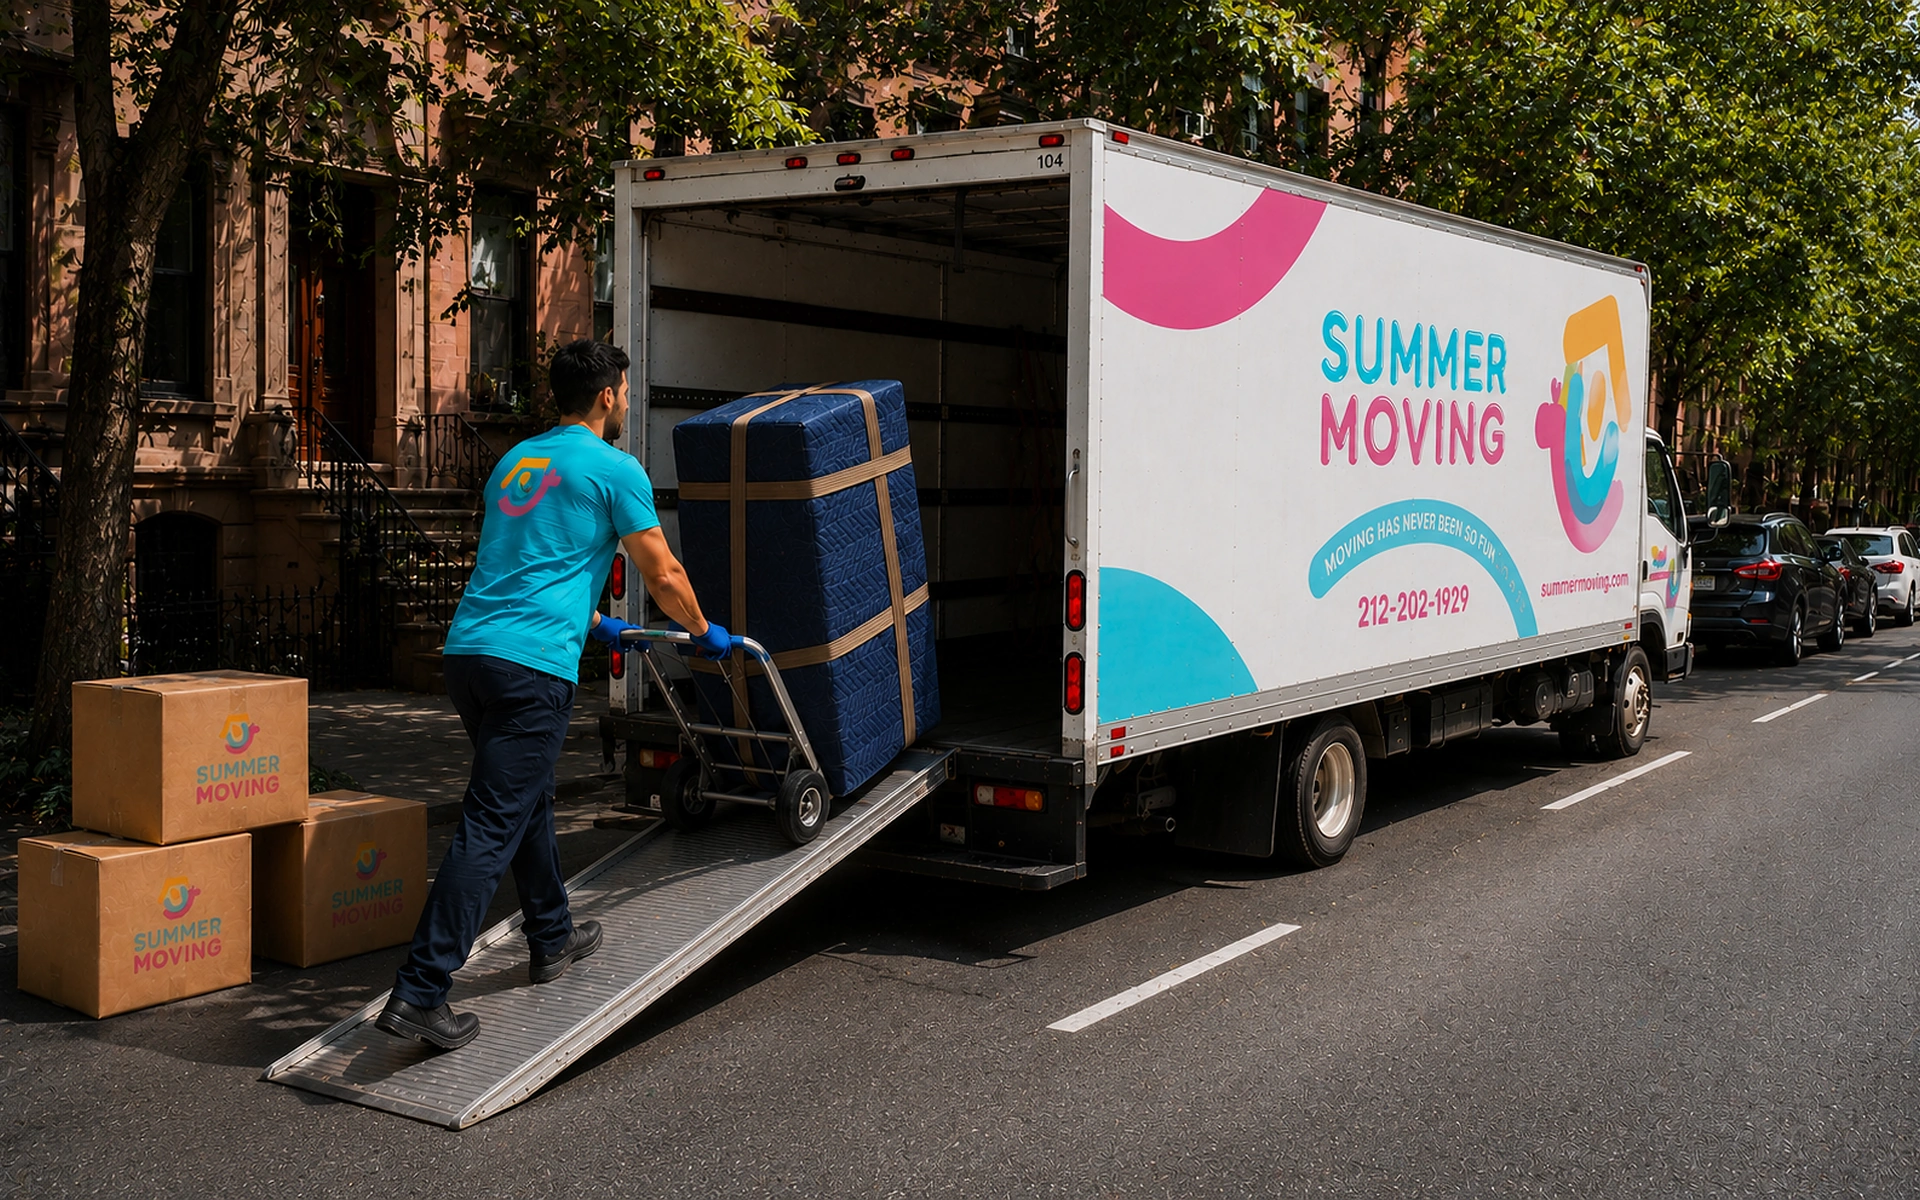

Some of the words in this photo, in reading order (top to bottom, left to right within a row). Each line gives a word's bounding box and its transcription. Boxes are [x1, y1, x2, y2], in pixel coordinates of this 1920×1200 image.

[1037, 153, 1064, 169] 104
[1321, 310, 1507, 394] SUMMER
[1320, 393, 1506, 466] MOVING
[1324, 526, 1375, 576] MOVING
[1377, 515, 1401, 541] HAS
[1402, 512, 1436, 532] NEVER
[1438, 514, 1463, 537] BEEN
[1464, 524, 1478, 546] SO
[1541, 573, 1629, 598] summermoving.com
[1358, 584, 1469, 628] 212-202-1929
[196, 754, 280, 785] SUMMER
[196, 775, 280, 805] MOVING
[332, 878, 404, 909] SUMMER
[332, 897, 404, 929] MOVING
[133, 917, 222, 952] SUMMER
[133, 938, 222, 975] MOVING
